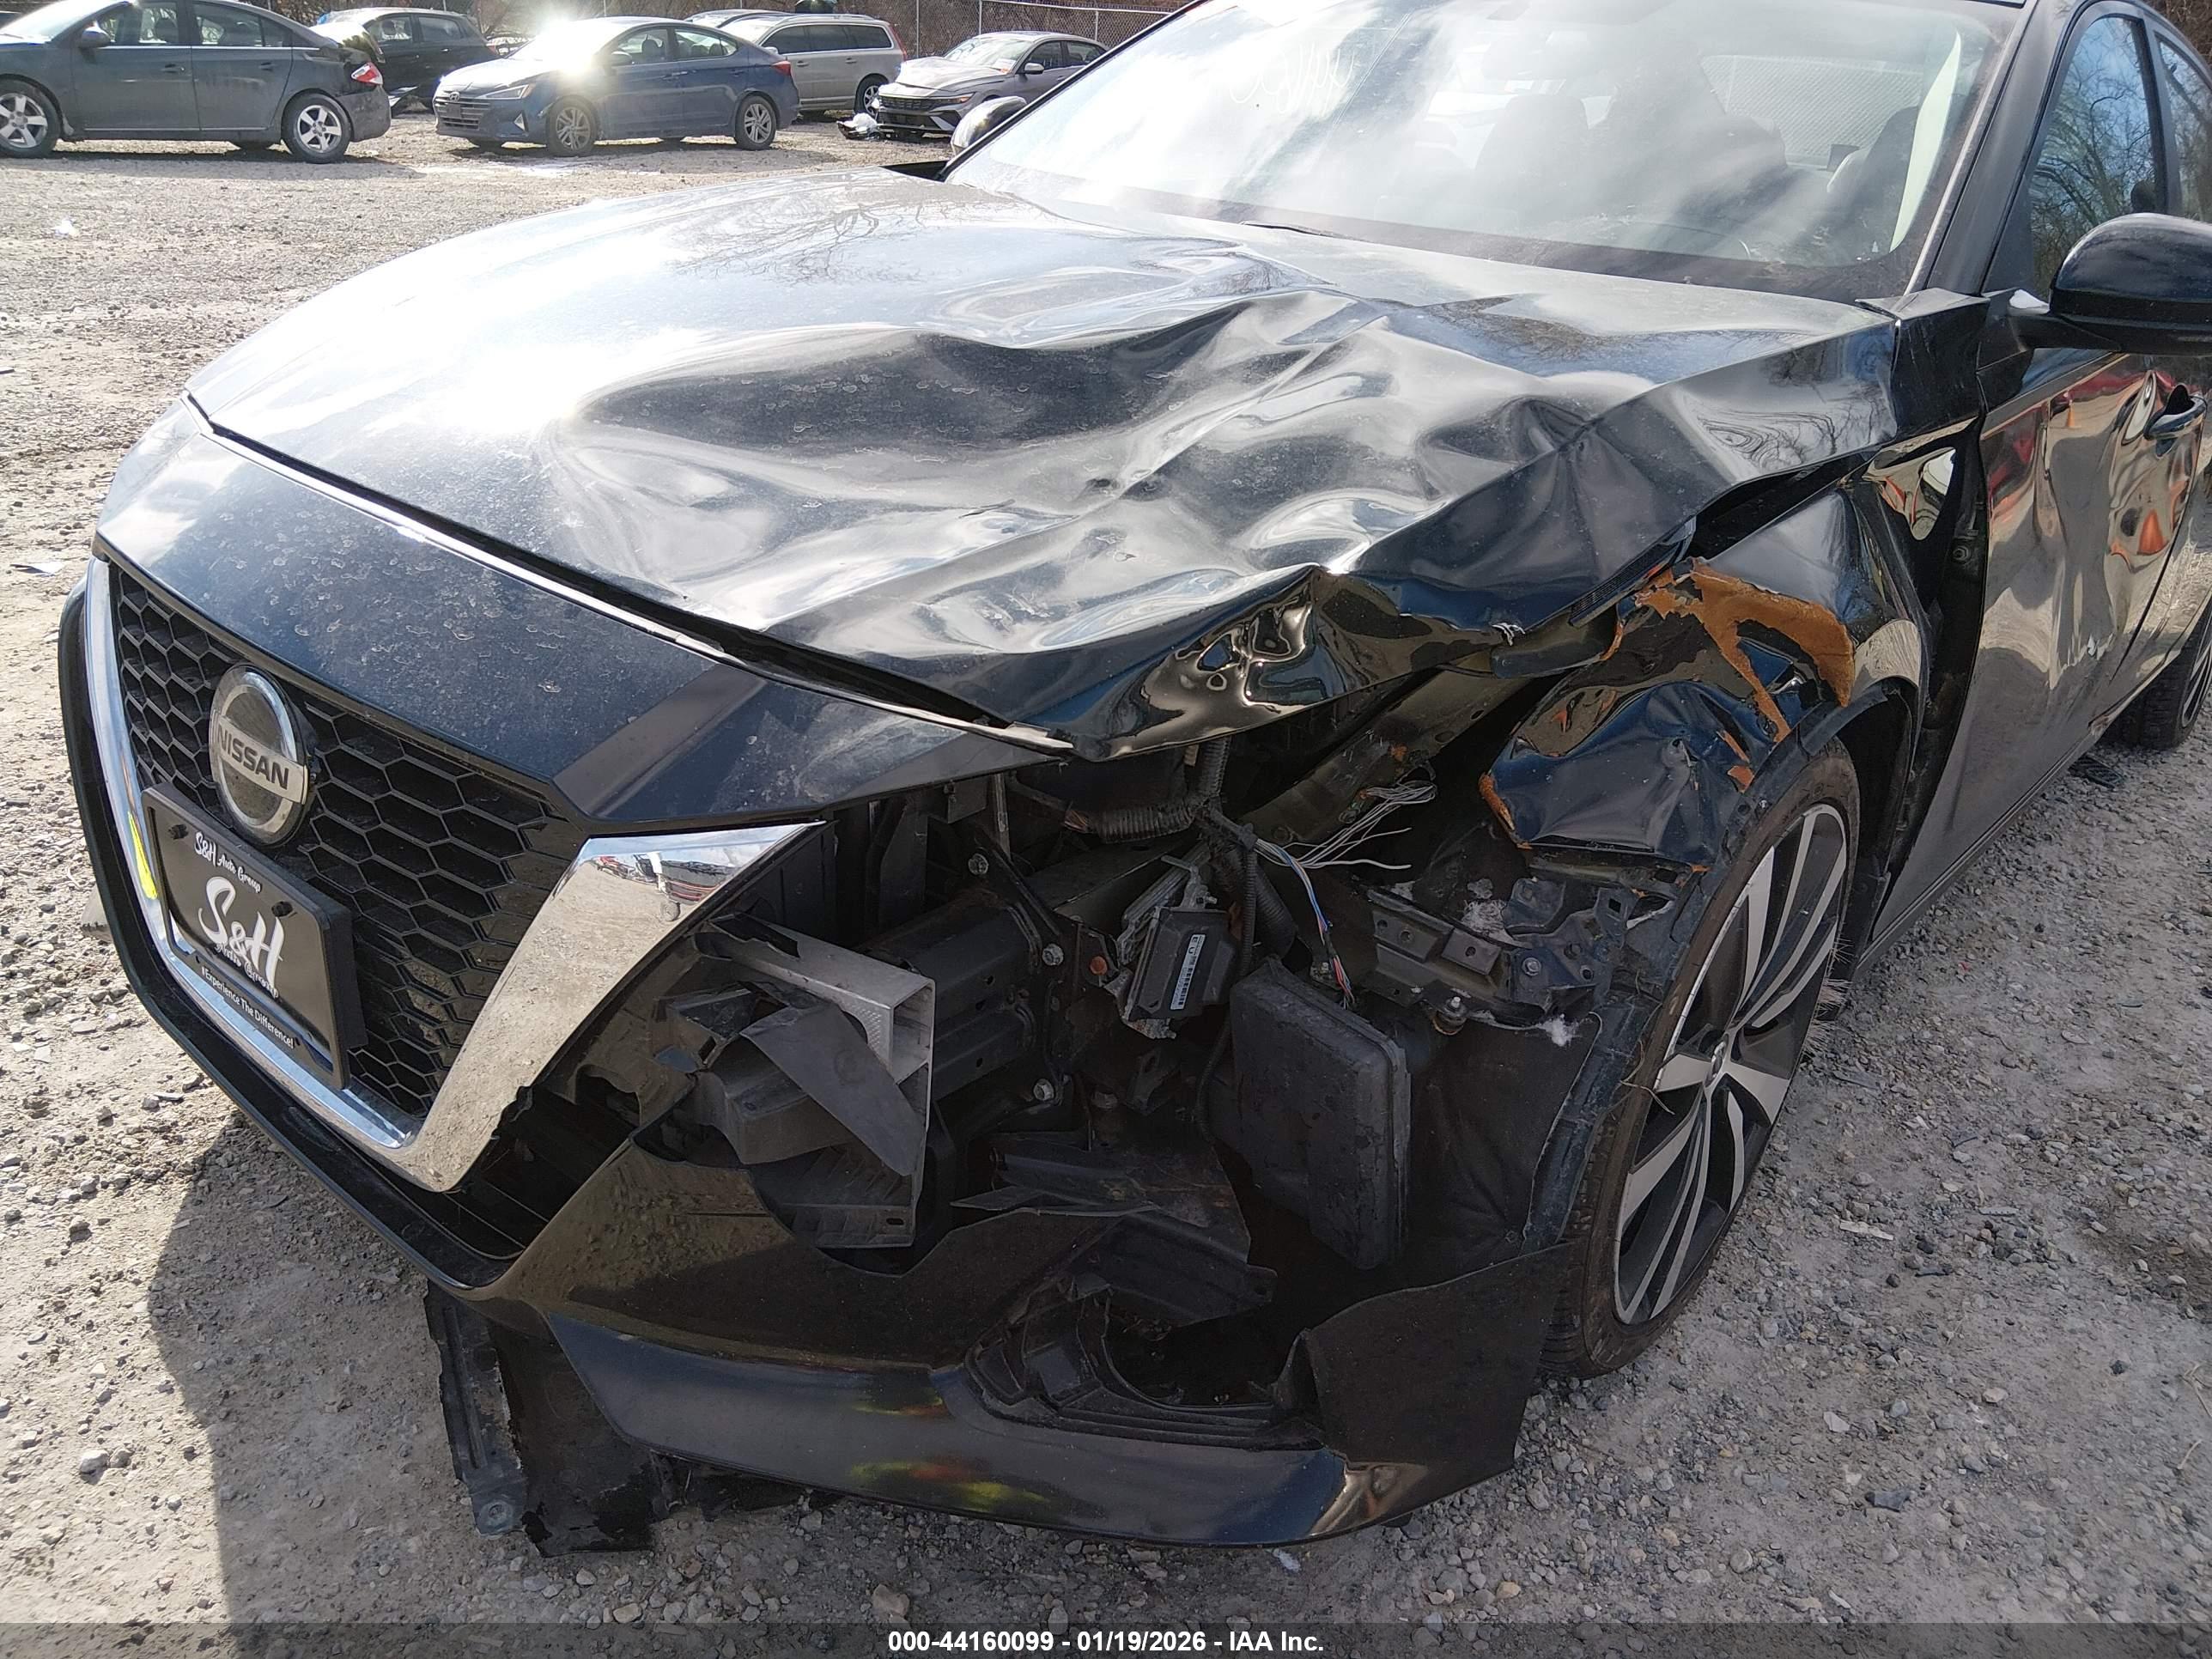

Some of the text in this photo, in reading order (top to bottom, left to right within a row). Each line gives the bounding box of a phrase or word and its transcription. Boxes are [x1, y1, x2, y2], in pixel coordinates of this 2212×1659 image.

[219, 723, 289, 790] NISSAN
[194, 831, 261, 894] S&H Auto Group
[198, 876, 283, 989] S&H
[244, 960, 279, 999] Group
[240, 998, 254, 1017] The
[254, 1009, 294, 1048] Difference!
